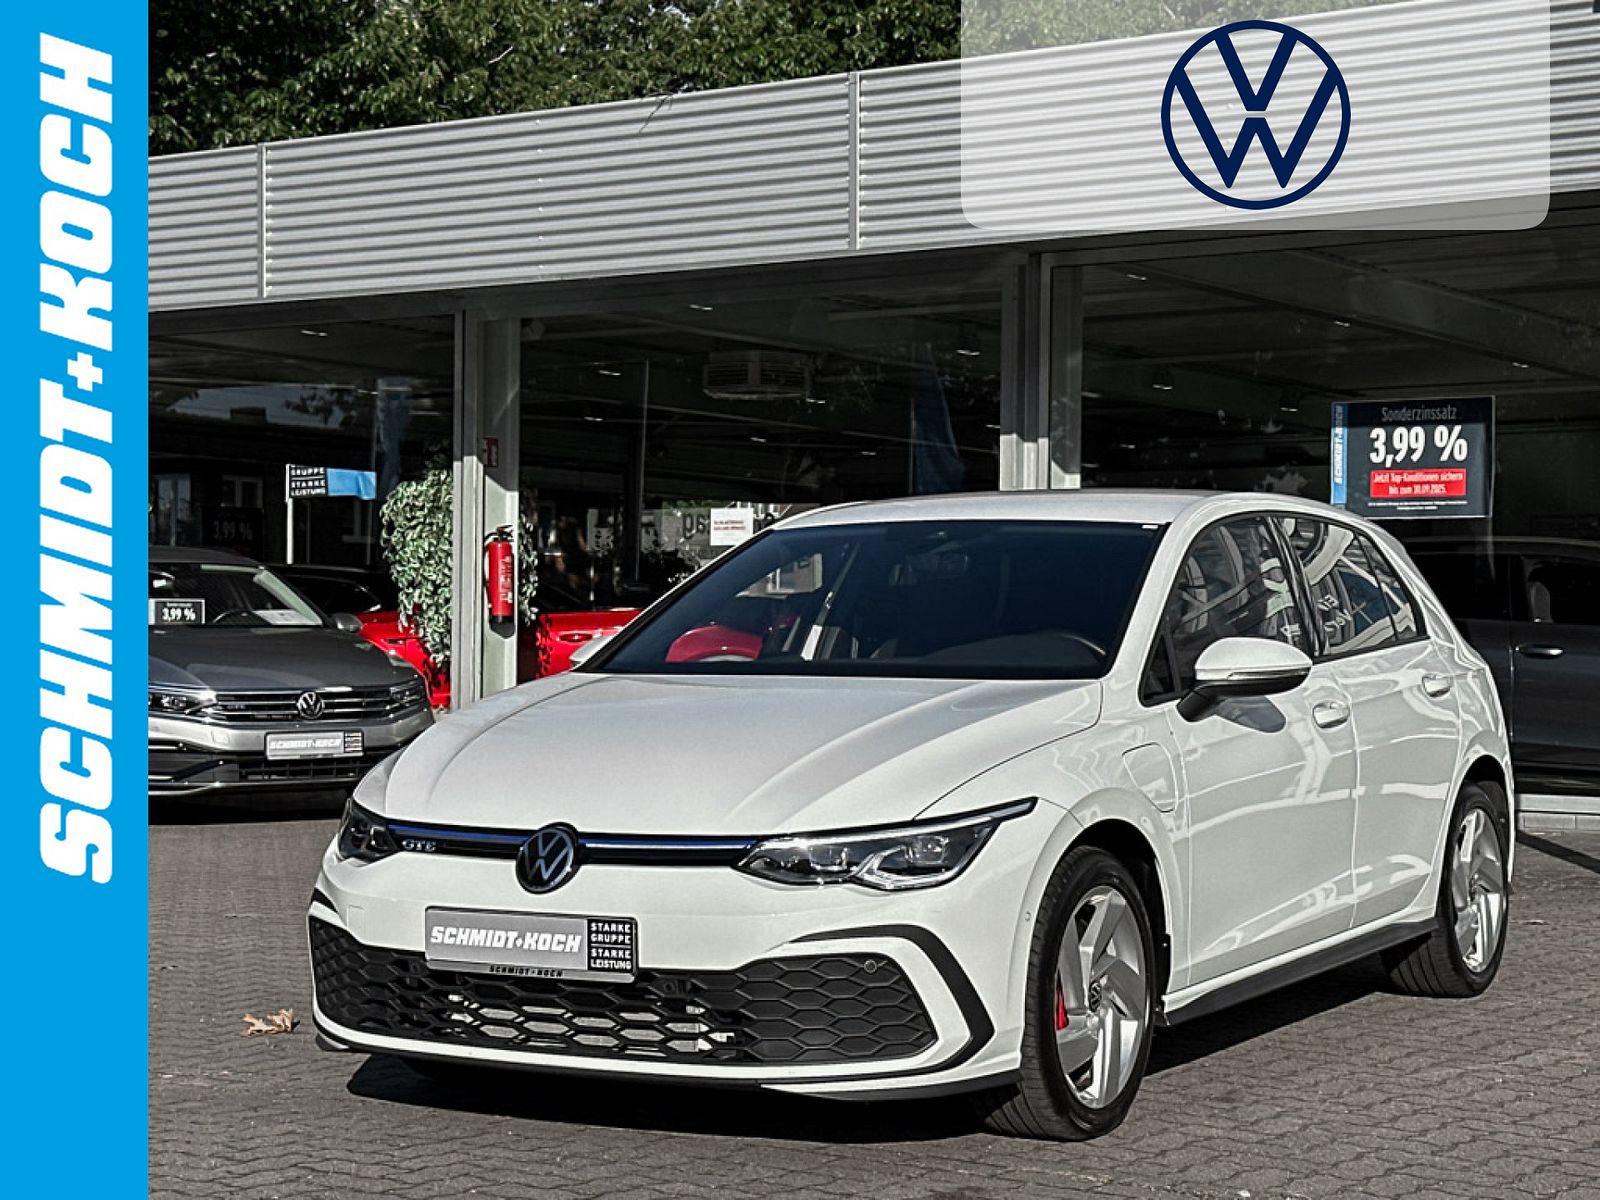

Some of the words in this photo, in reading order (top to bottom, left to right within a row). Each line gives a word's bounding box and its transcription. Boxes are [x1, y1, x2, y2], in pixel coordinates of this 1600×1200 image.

[1381, 404, 1457, 422] Sonderzinssatz
[1369, 426, 1426, 467] 3,99
[1434, 424, 1468, 462] %
[1388, 484, 1399, 494] bis
[162, 607, 182, 622] 3,99
[401, 839, 436, 852] GTE
[590, 921, 631, 934] STARKE
[430, 925, 582, 953] SCHMIDT+KOCH
[590, 932, 631, 945] GRUPPE
[590, 948, 632, 960] STARKE
[590, 958, 632, 970] LEISTUNG
